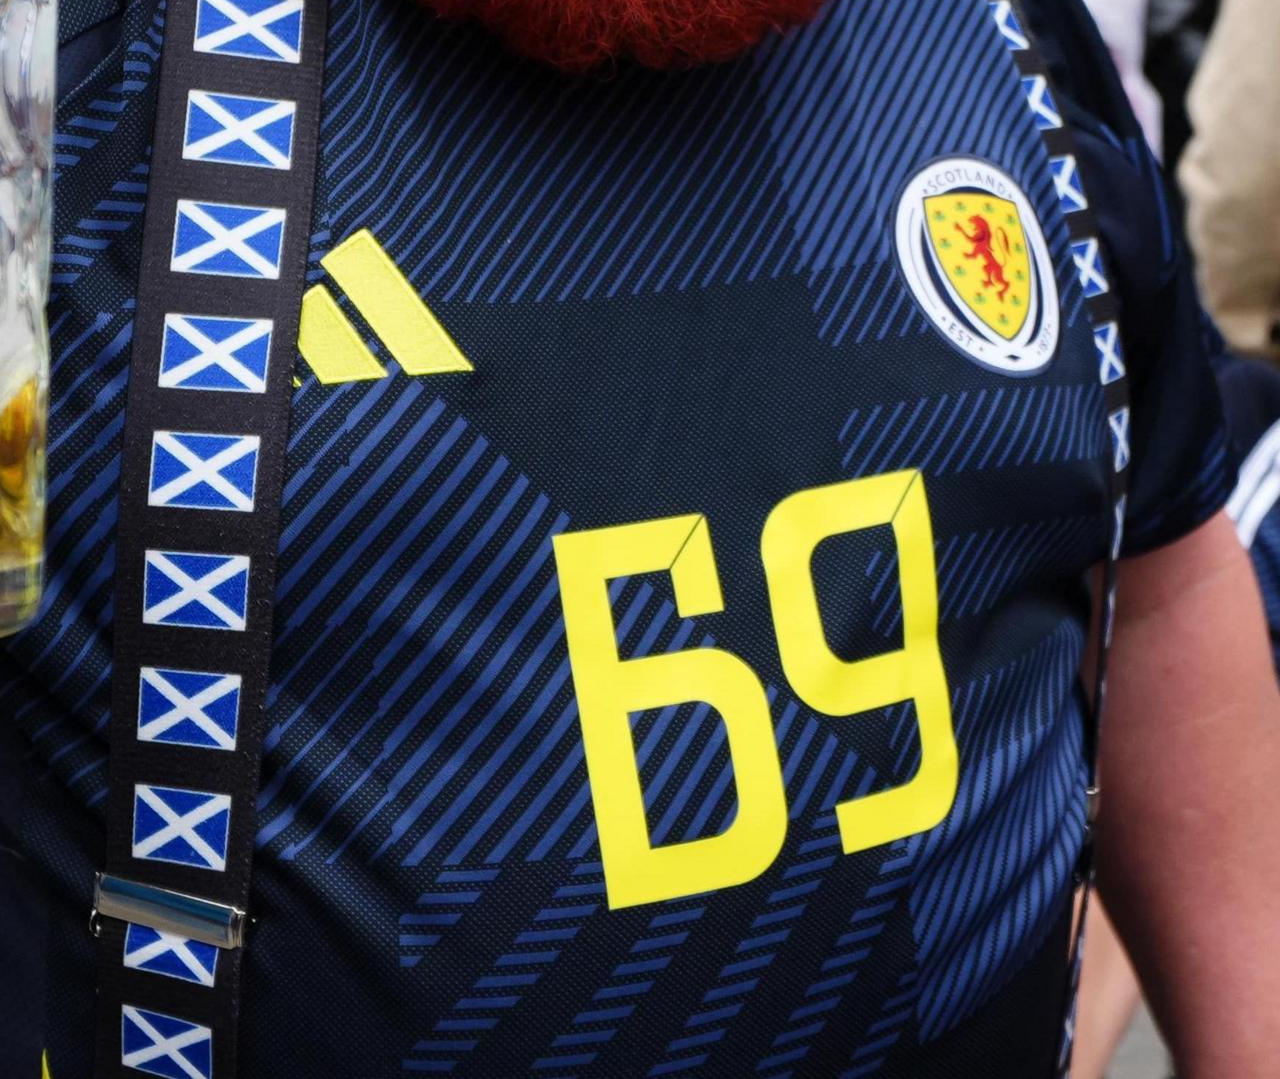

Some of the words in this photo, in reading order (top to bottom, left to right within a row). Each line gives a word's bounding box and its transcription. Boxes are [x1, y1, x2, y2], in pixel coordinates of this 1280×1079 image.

[927, 168, 1007, 195] SCOTLAND
[948, 322, 973, 347] EST
[551, 467, 960, 910] 69
